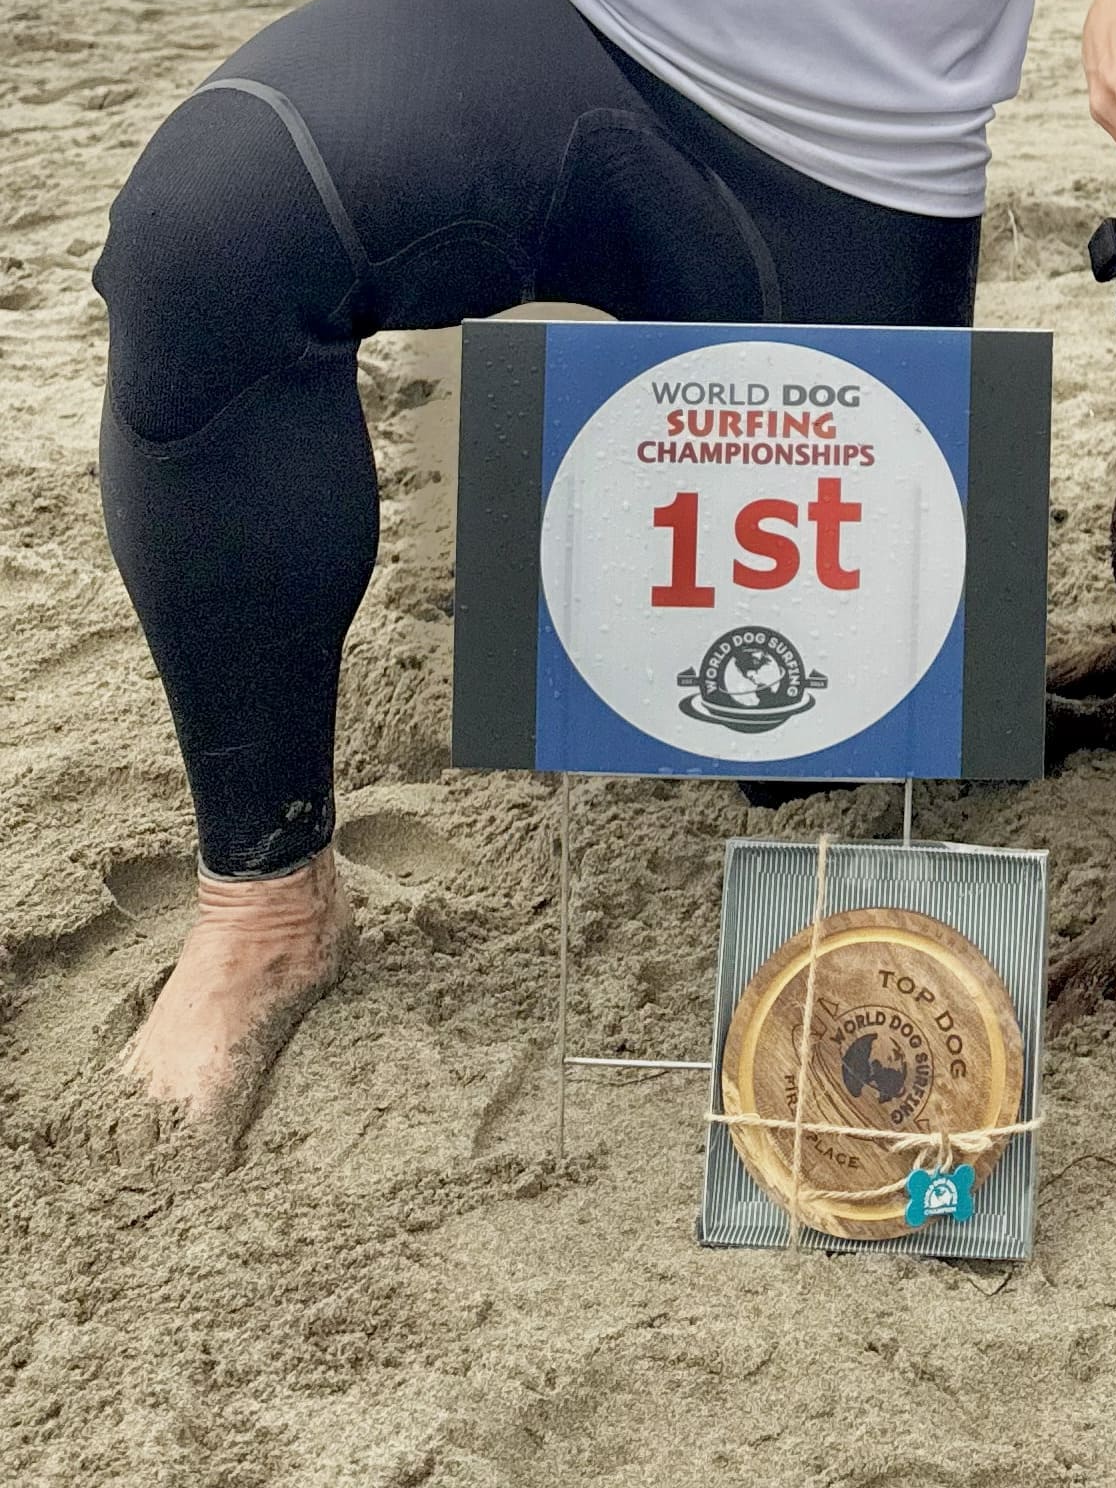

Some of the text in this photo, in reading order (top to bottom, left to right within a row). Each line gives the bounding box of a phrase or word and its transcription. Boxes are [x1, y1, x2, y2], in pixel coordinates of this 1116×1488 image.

[651, 381, 861, 408] WORLD DOG
[667, 408, 837, 440] SURFING
[637, 440, 876, 467] CHAMPIONSHIPS
[651, 477, 862, 608] 1st
[704, 631, 800, 698] WORLD DOG SURFING
[878, 969, 936, 1004] TOP
[934, 1009, 967, 1080] DOG
[829, 1011, 930, 1125] WORLD DOG SURFING
[806, 1131, 861, 1169] PLACE
